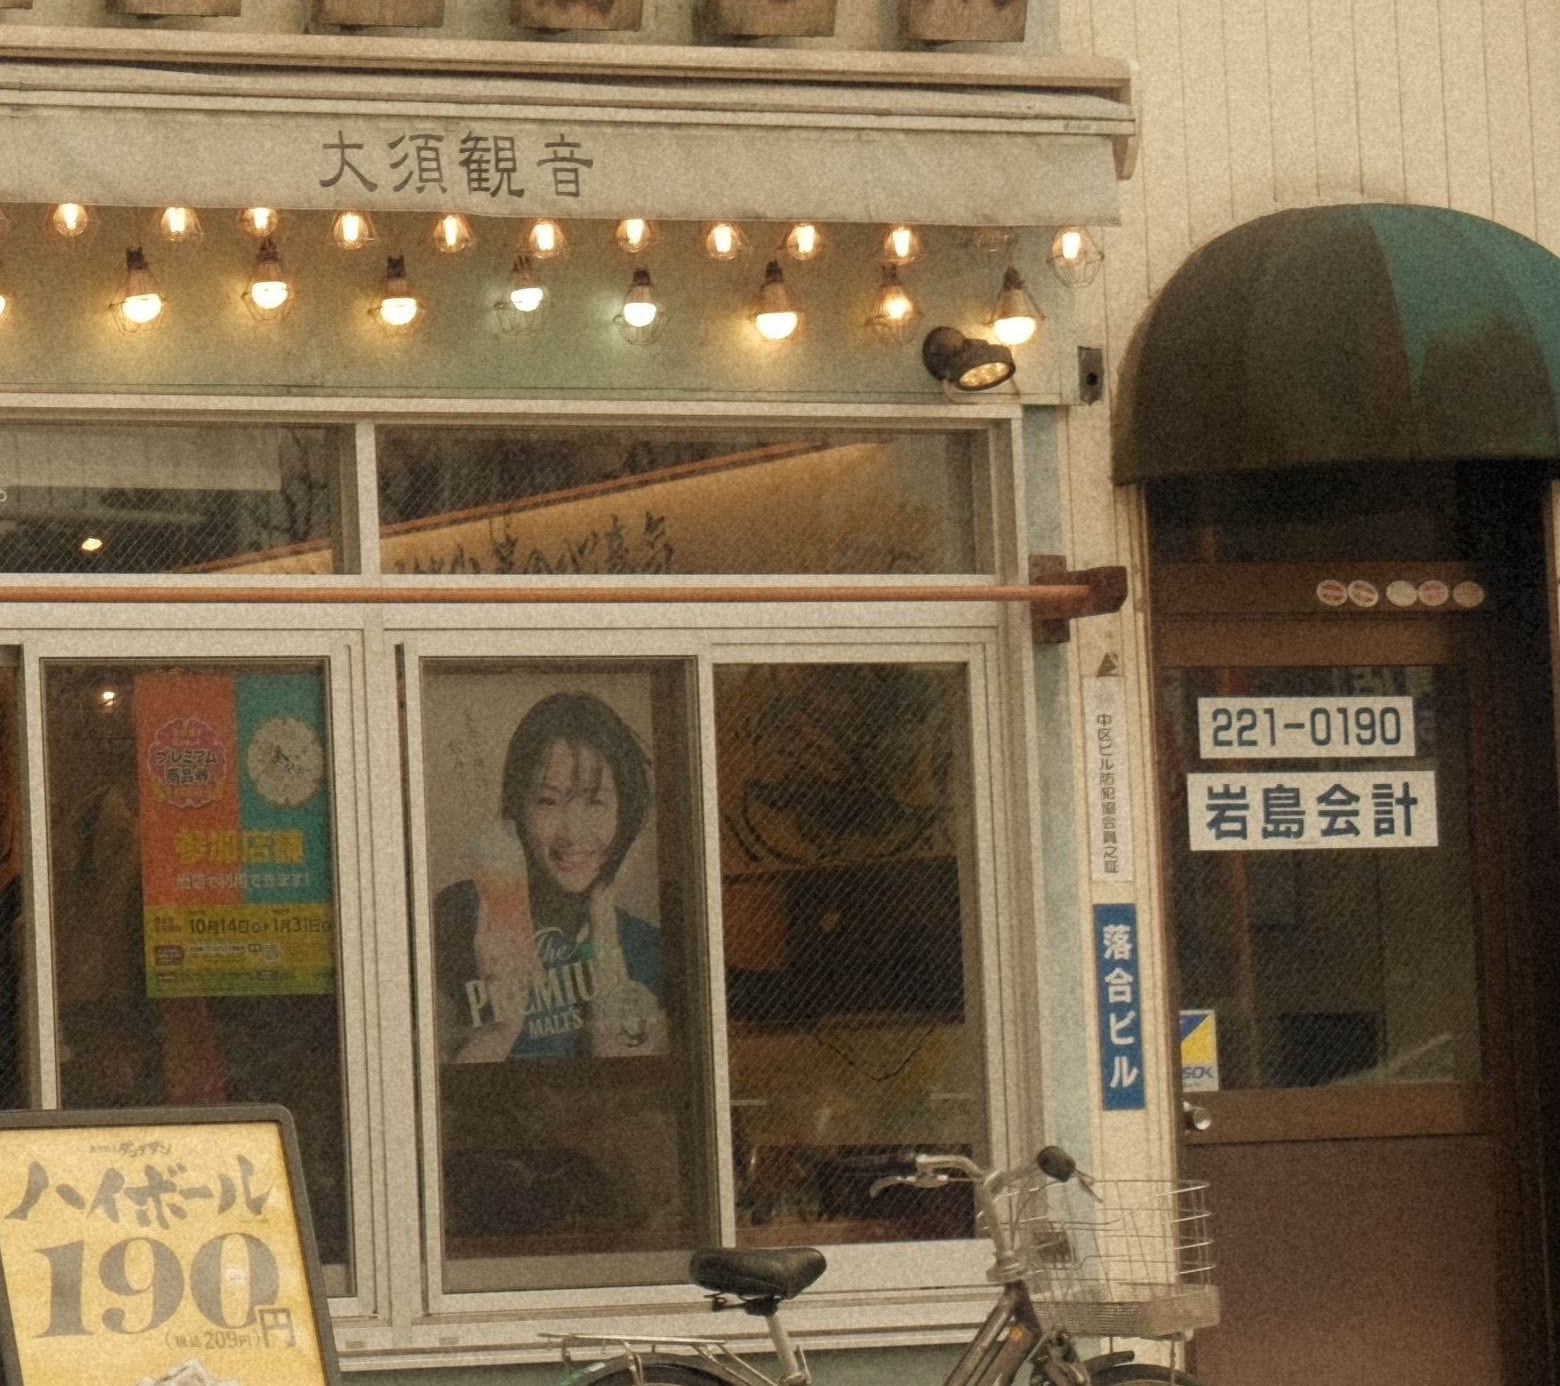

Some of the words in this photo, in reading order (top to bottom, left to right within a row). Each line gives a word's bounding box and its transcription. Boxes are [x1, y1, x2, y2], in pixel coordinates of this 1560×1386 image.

[318, 128, 596, 205] 大須観音
[1212, 705, 1404, 748] 221-0190
[1206, 782, 1419, 842] 岩島会計
[1102, 923, 1138, 1090] 落合ビル
[1182, 1066, 1215, 1079] SOK
[5, 1153, 275, 1231] ハイボール
